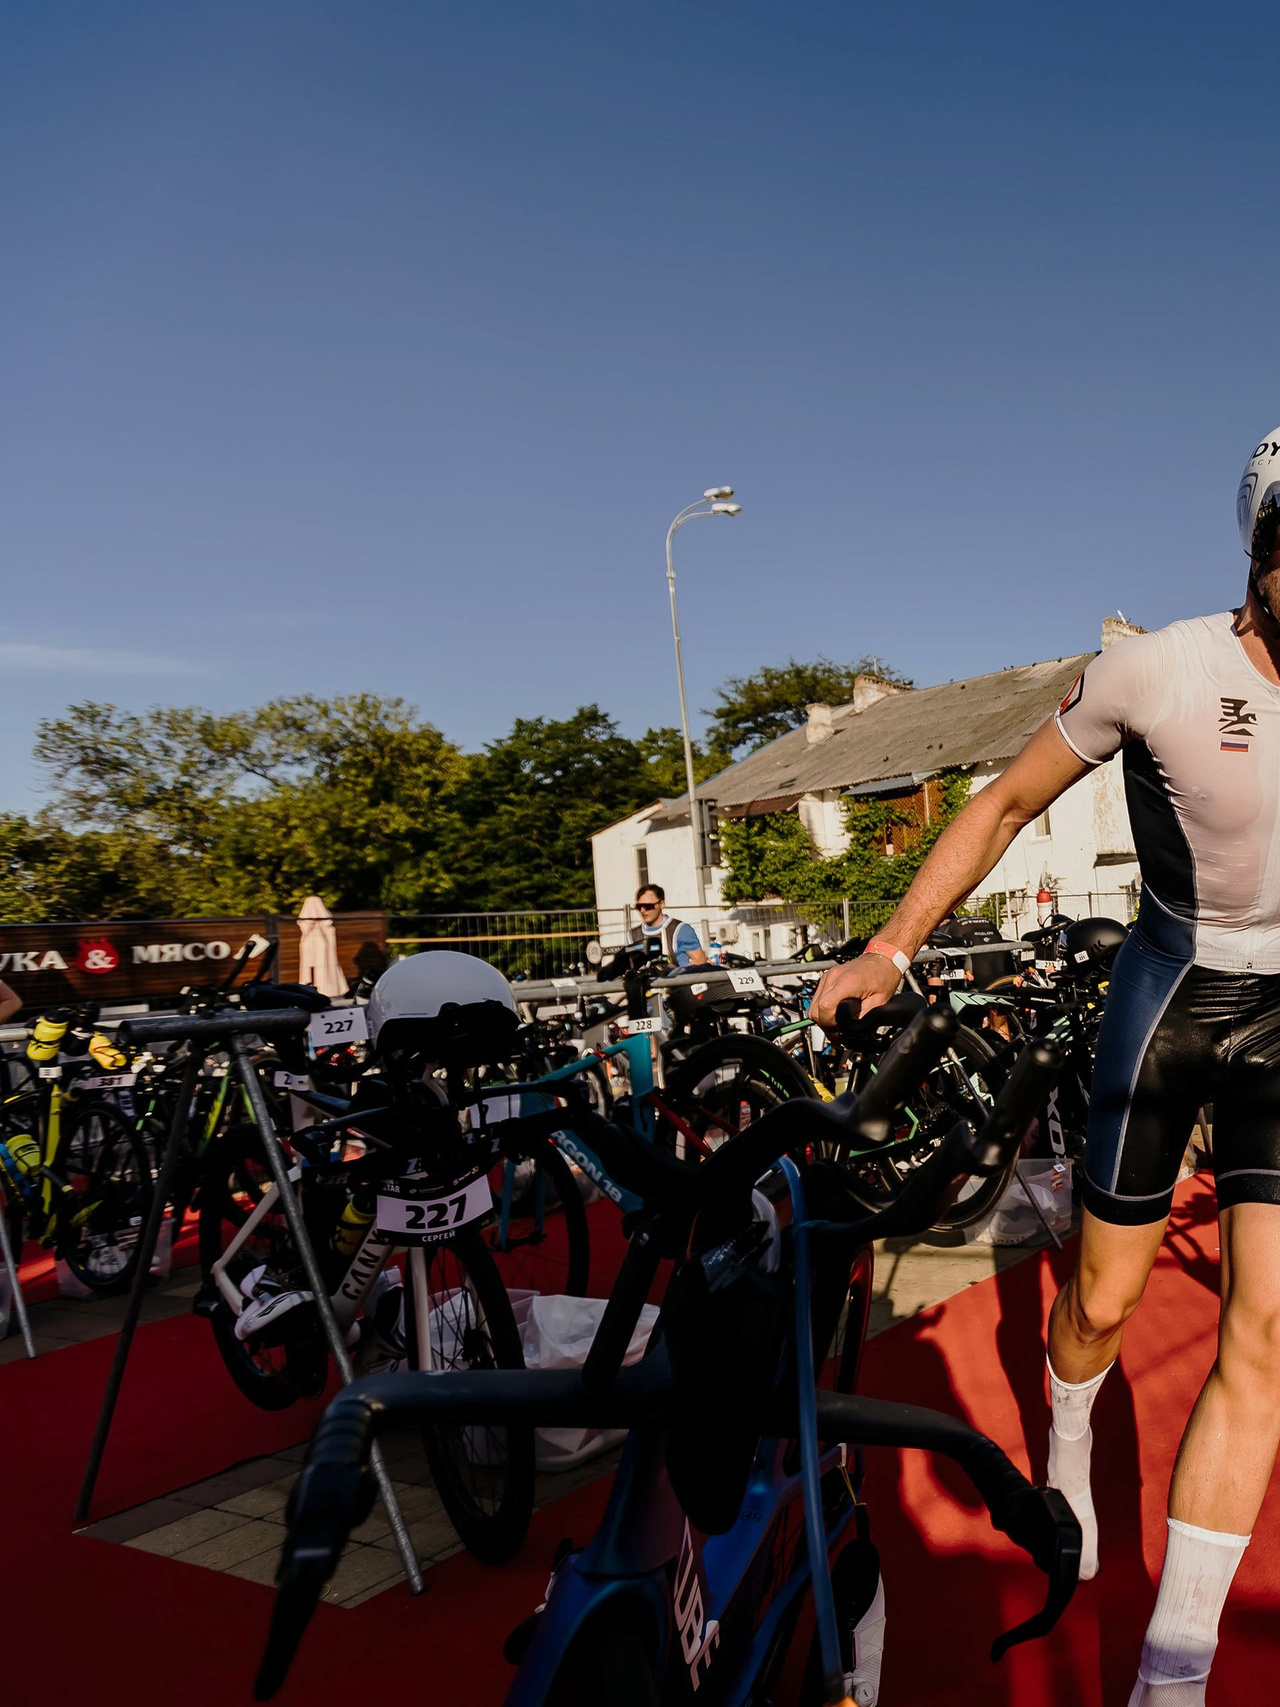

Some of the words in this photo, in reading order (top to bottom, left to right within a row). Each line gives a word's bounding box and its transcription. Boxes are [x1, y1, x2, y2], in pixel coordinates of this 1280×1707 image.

[83, 948, 116, 971] &
[131, 940, 232, 965] МЯСО
[737, 977, 755, 987] 229
[323, 1019, 354, 1035] 227
[635, 1019, 653, 1031] 228
[550, 1130, 601, 1182] RGON
[603, 1182, 623, 1202] 18
[405, 1193, 467, 1229] 227
[421, 1230, 456, 1243] СЕРГЕЙ
